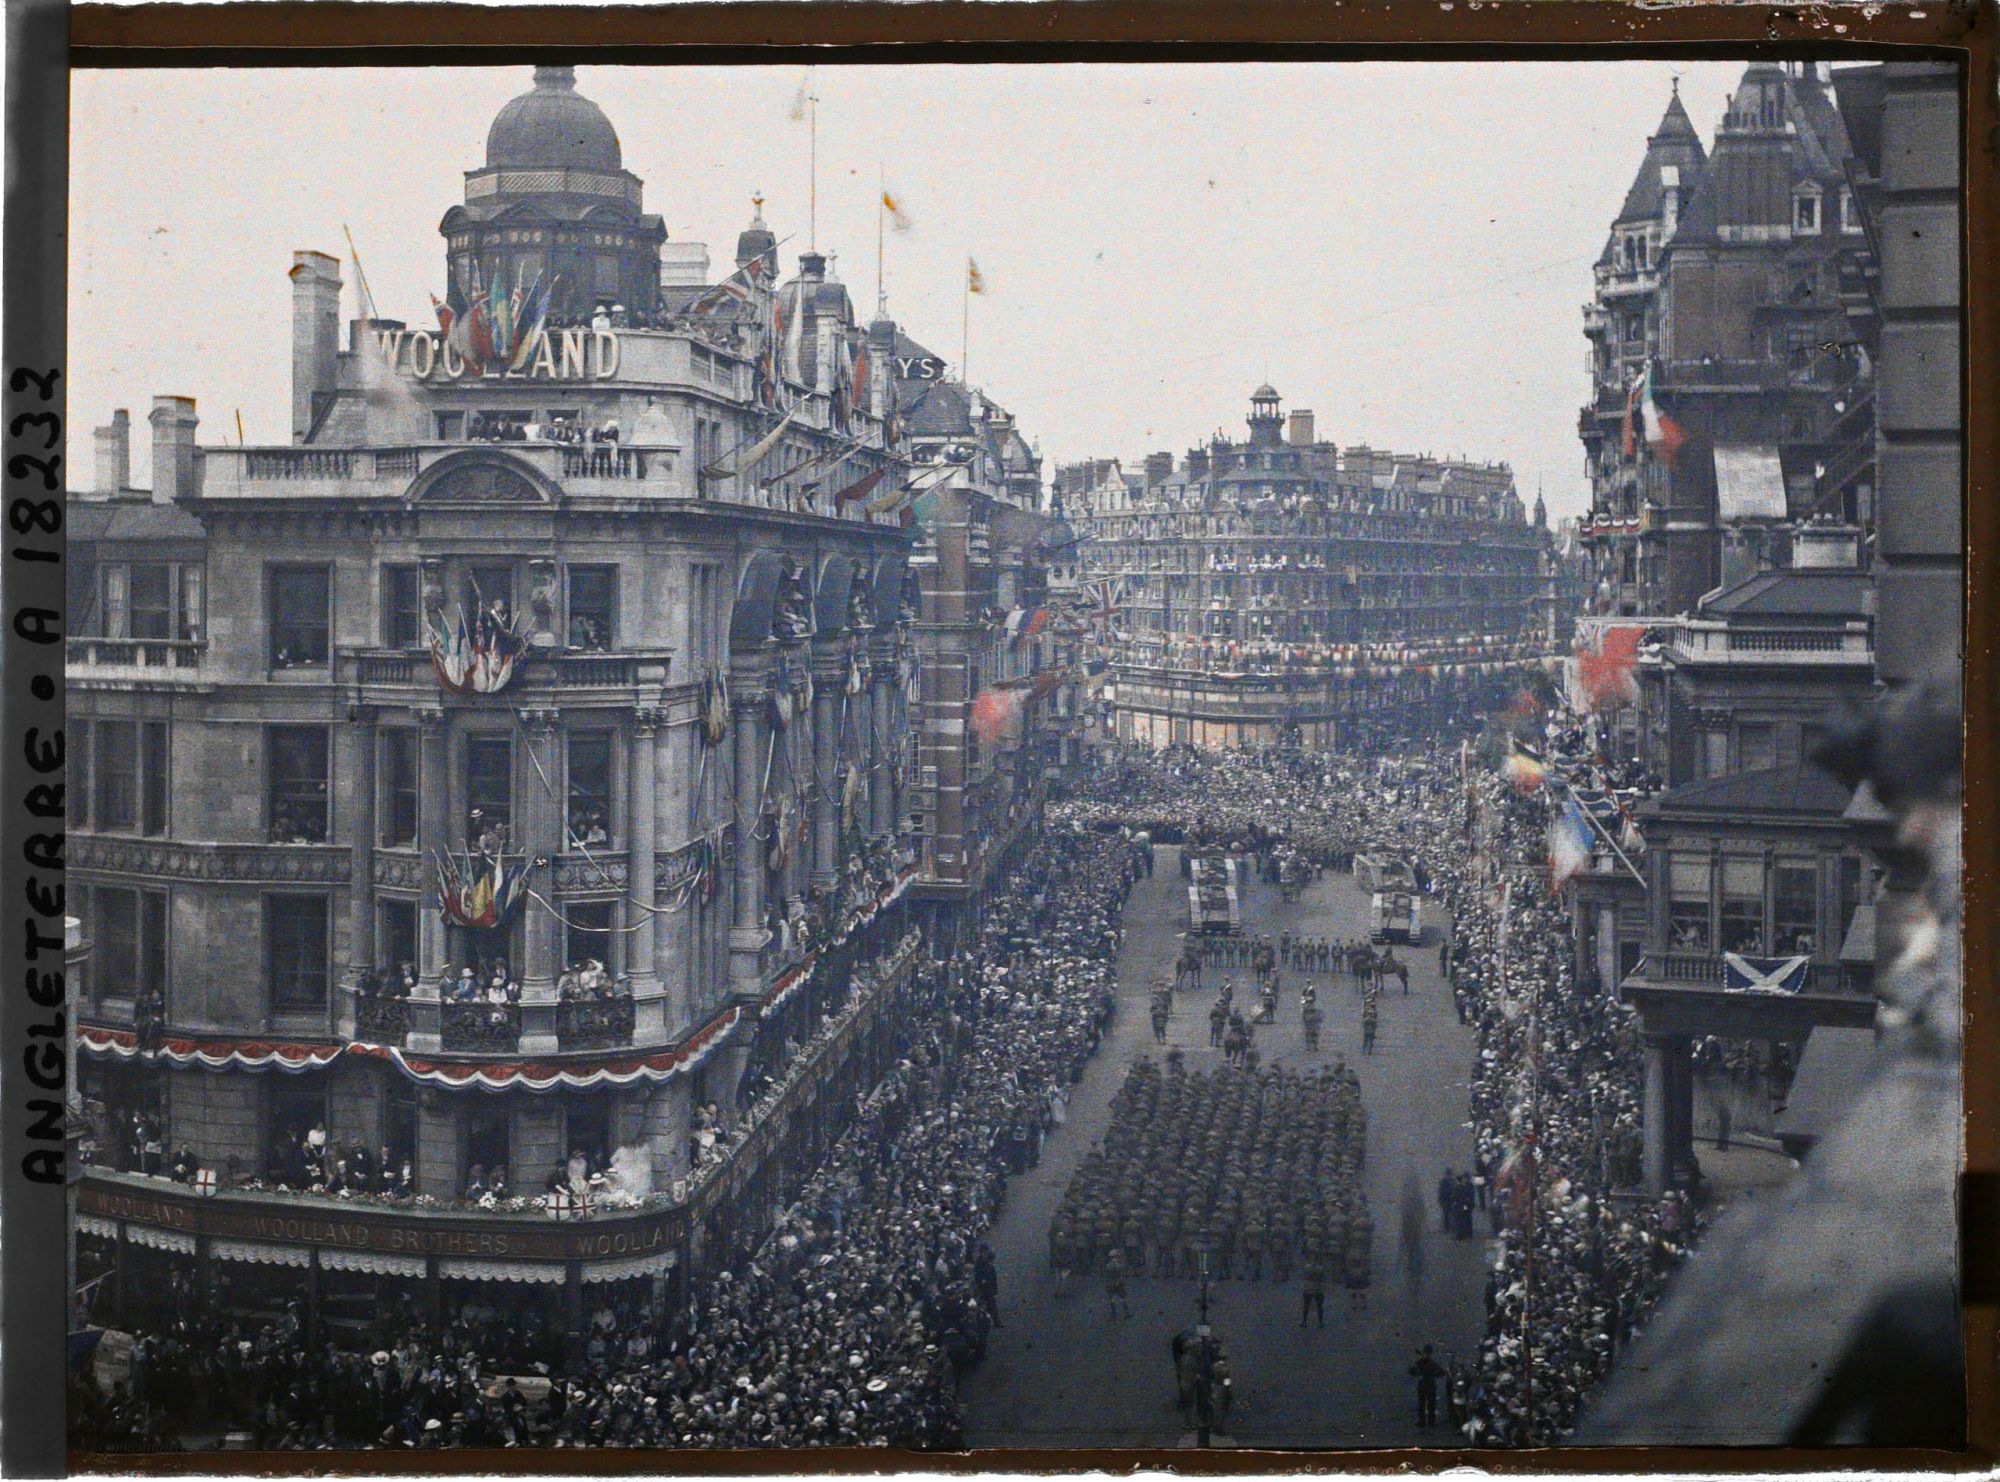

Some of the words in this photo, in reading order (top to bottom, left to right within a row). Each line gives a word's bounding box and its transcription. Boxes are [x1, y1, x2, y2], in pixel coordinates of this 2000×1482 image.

[97, 1191, 185, 1227] WOOLLAND
[255, 1217, 369, 1246] WOOLLAND
[390, 1228, 508, 1255] BROTHERS
